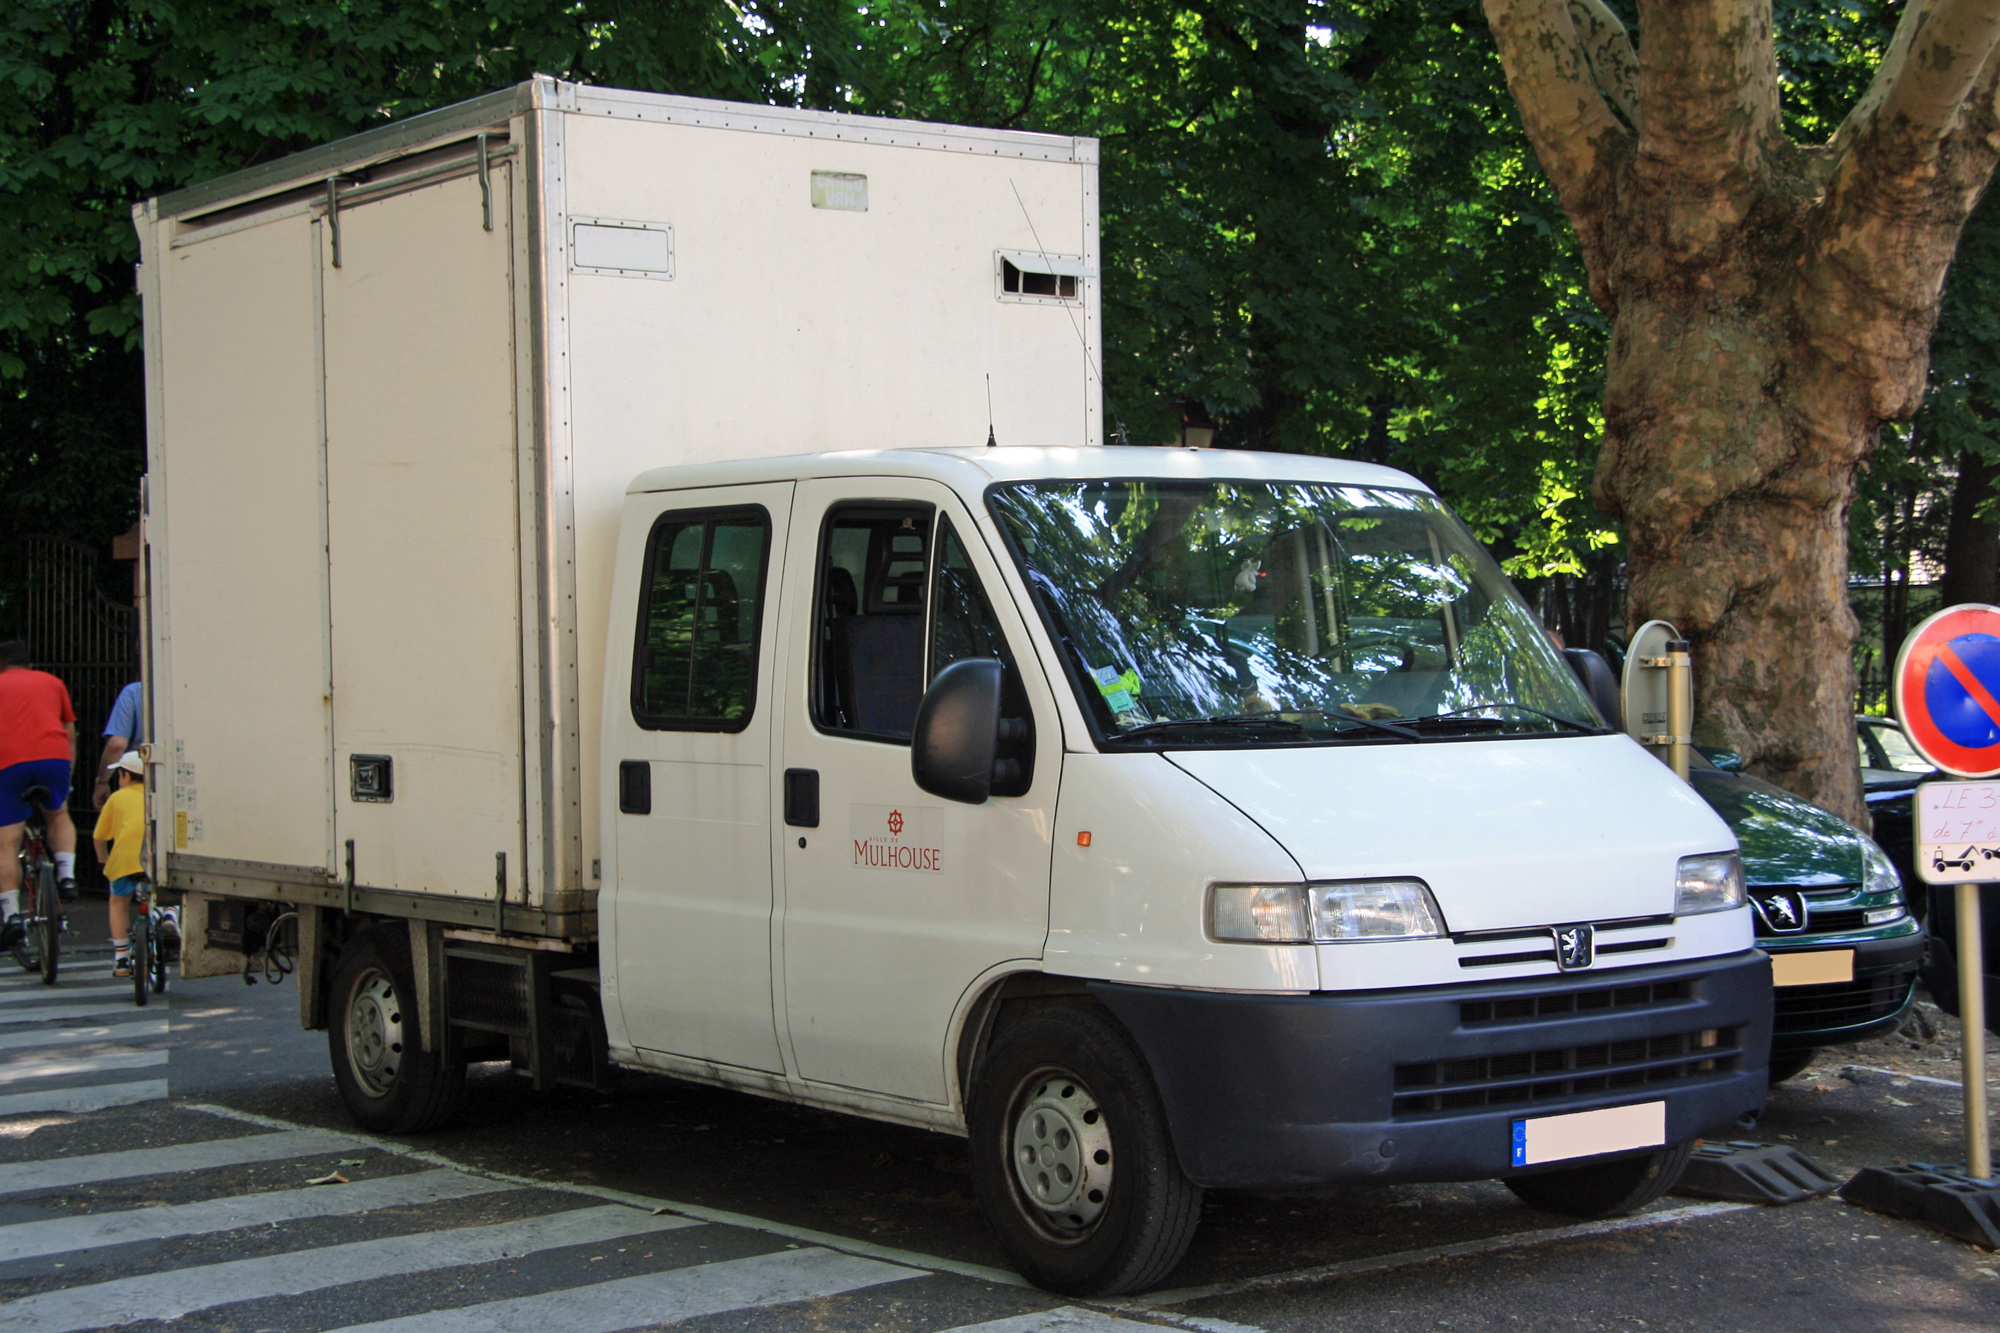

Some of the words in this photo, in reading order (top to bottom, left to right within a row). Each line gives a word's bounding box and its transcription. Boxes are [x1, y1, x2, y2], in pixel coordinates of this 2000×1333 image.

[825, 190, 856, 207] VAN
[1942, 788, 1972, 809] LE
[1933, 821, 1950, 838] de
[1516, 1147, 1522, 1157] F
